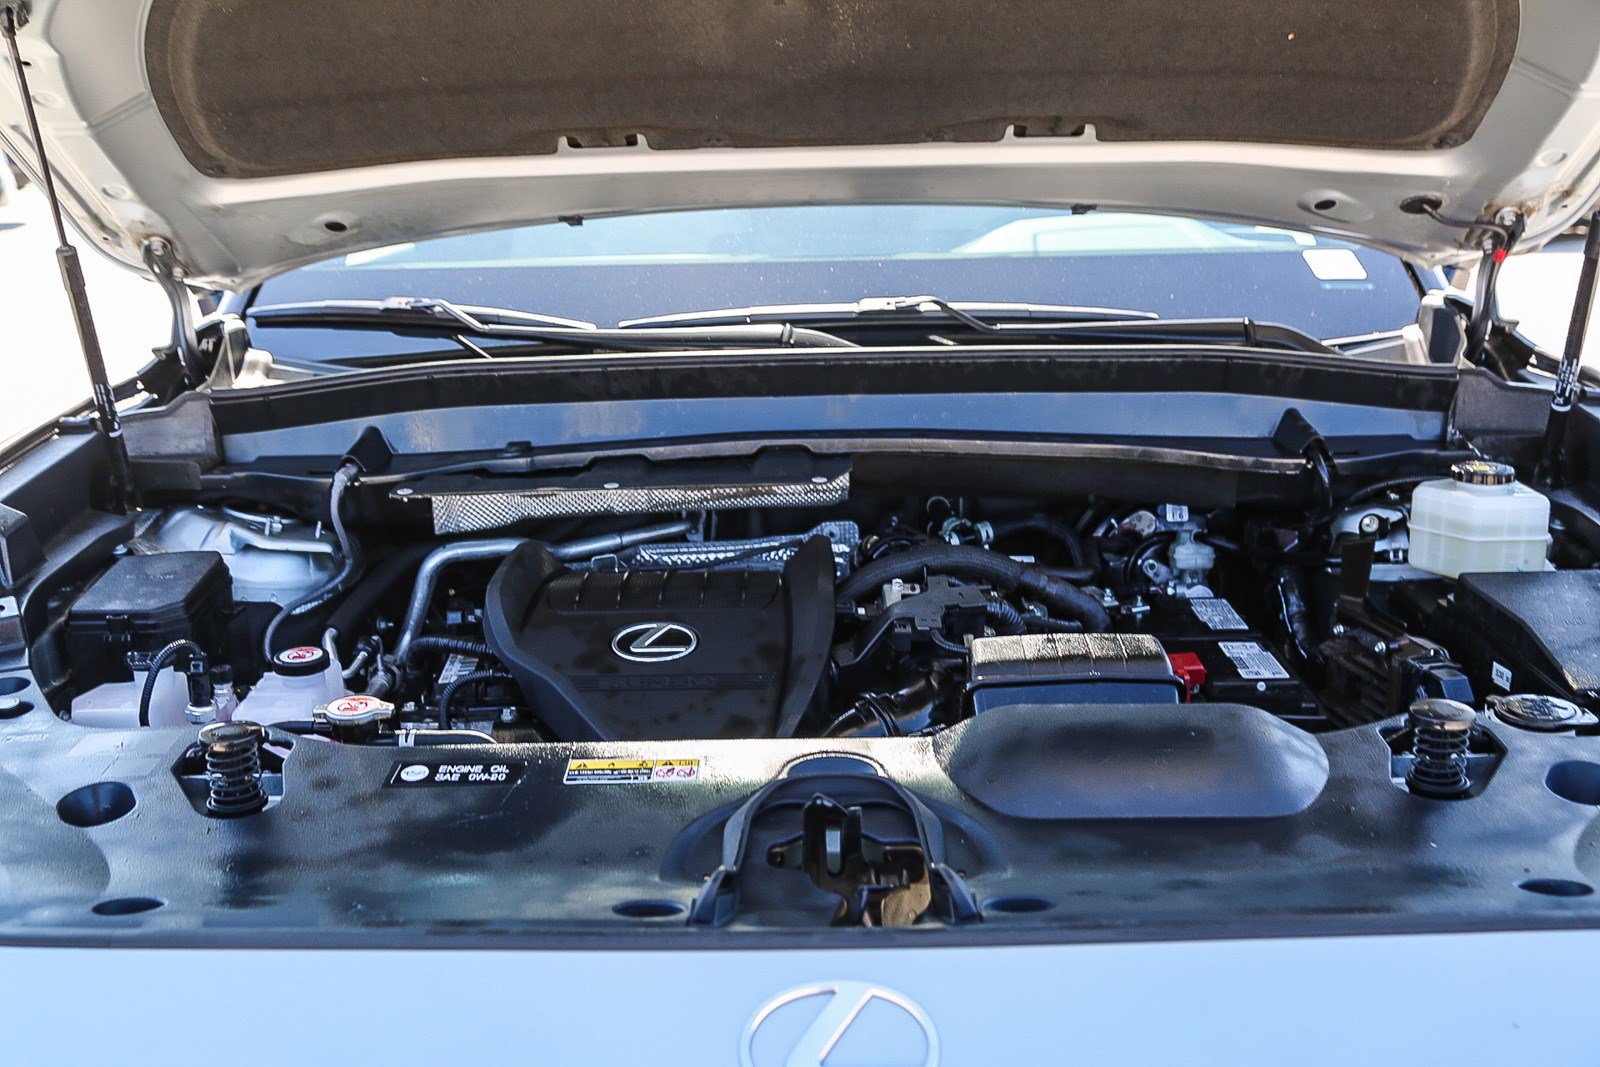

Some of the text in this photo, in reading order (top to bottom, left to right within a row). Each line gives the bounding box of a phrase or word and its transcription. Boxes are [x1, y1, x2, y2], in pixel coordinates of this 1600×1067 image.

[438, 764, 484, 774] ENGINE
[490, 764, 510, 774] OIL
[434, 772, 461, 782] SAE
[468, 772, 507, 782] 0W-20
